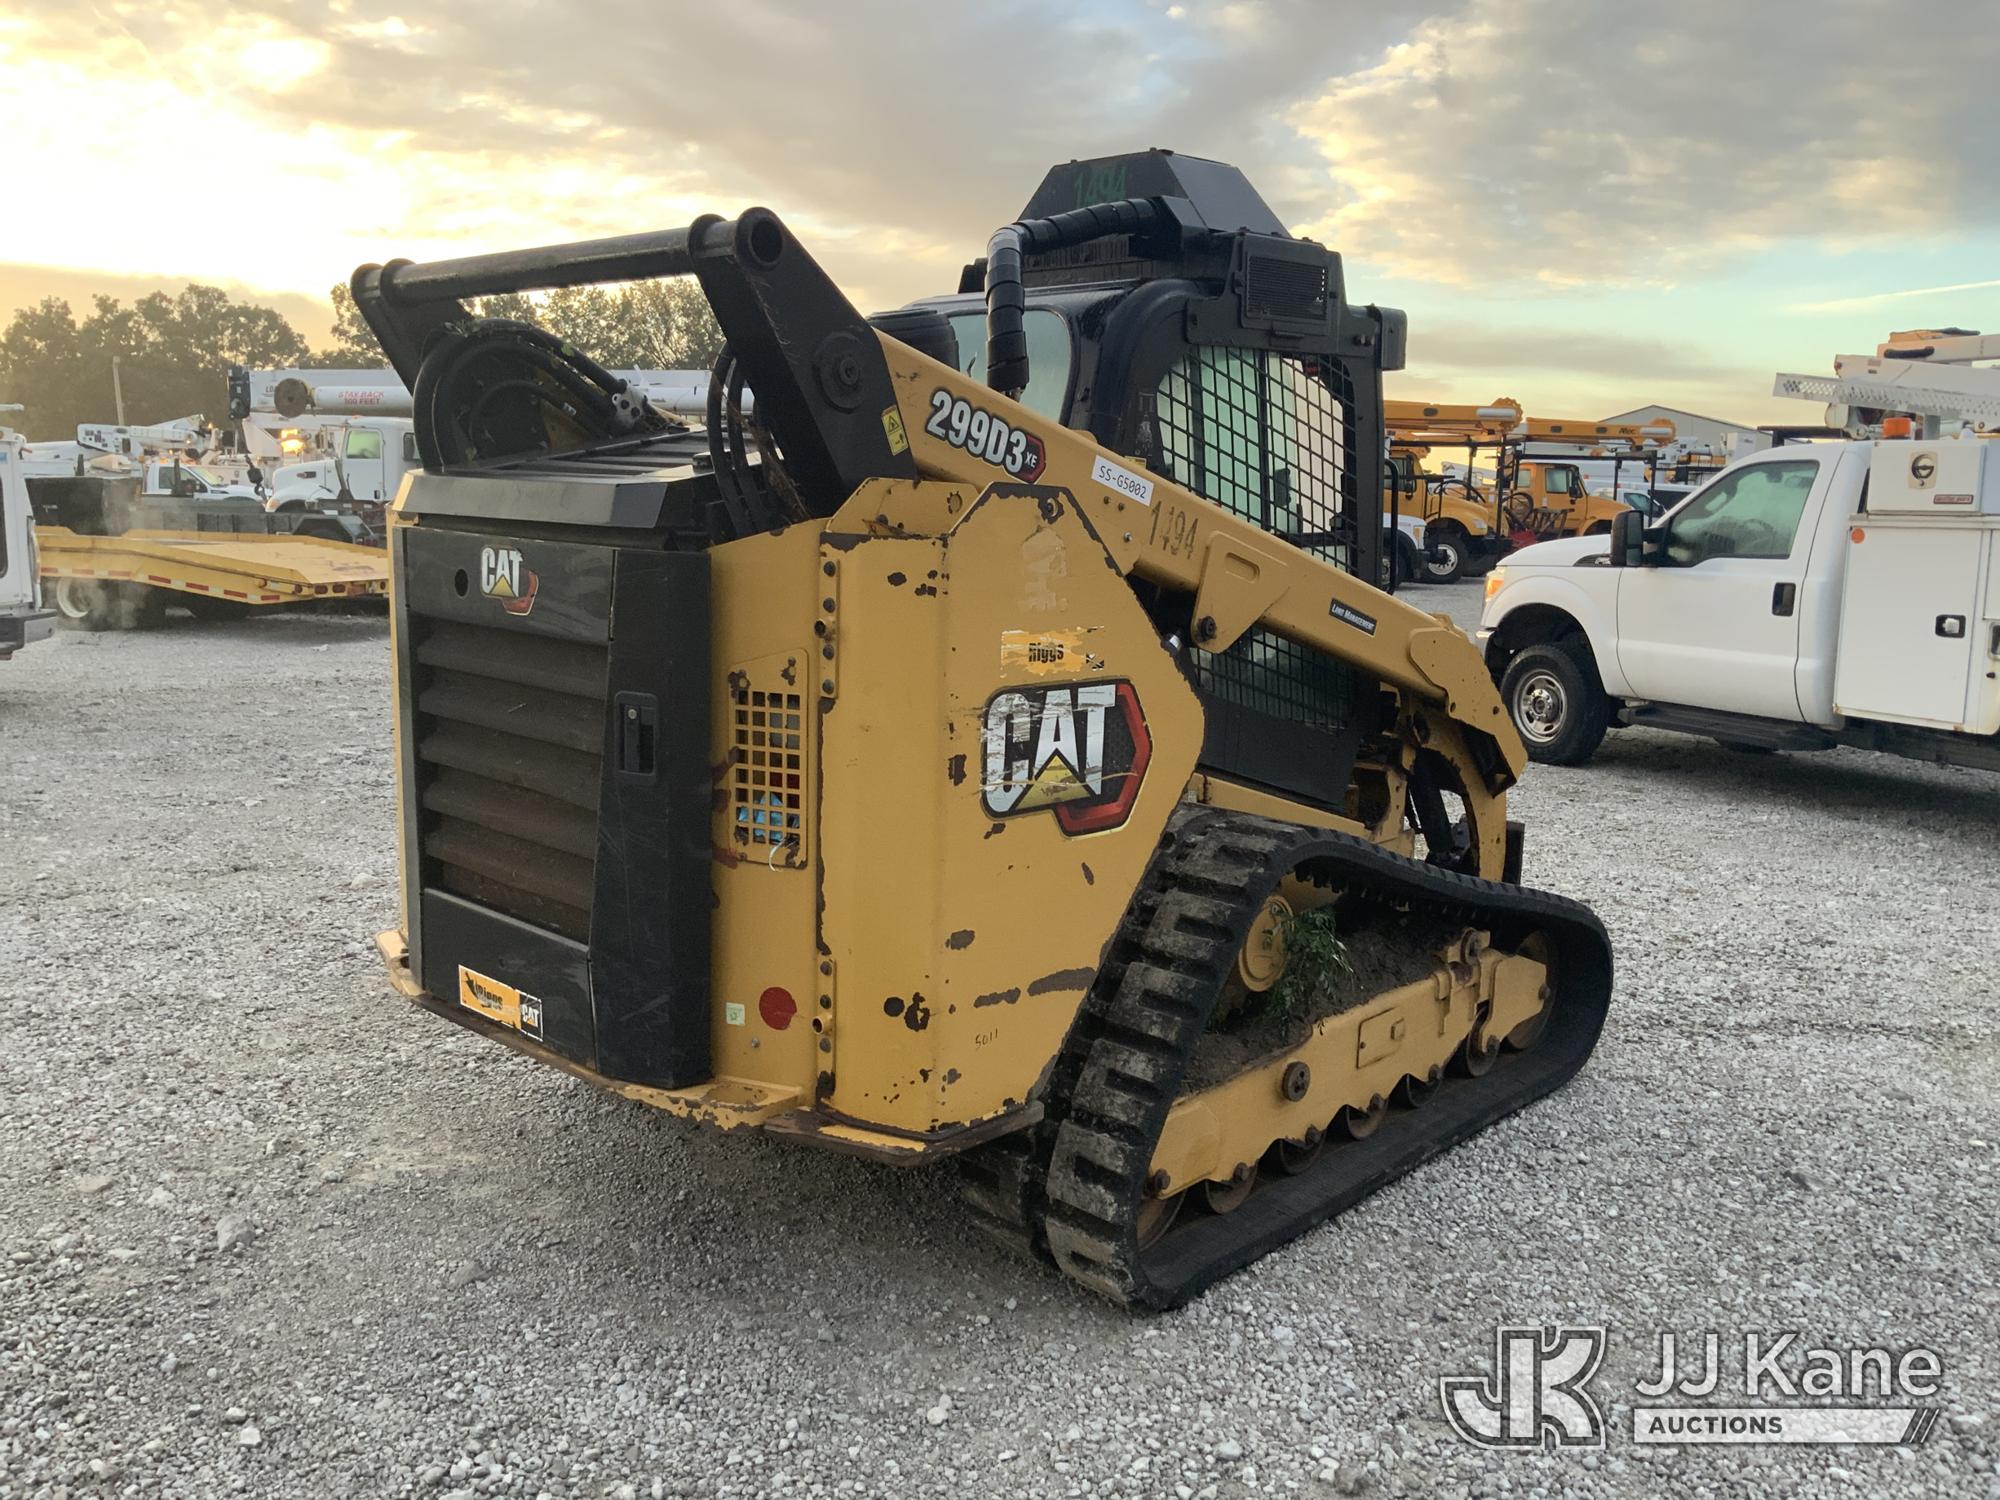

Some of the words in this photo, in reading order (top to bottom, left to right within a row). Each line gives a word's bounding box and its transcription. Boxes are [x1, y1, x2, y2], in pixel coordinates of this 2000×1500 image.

[926, 390, 1027, 473] 299D3
[1024, 451, 1038, 468] XE
[1098, 465, 1147, 499] SS-G5002
[481, 547, 524, 598] CAT
[985, 684, 1117, 813] CAT
[521, 1004, 540, 1028] CAT
